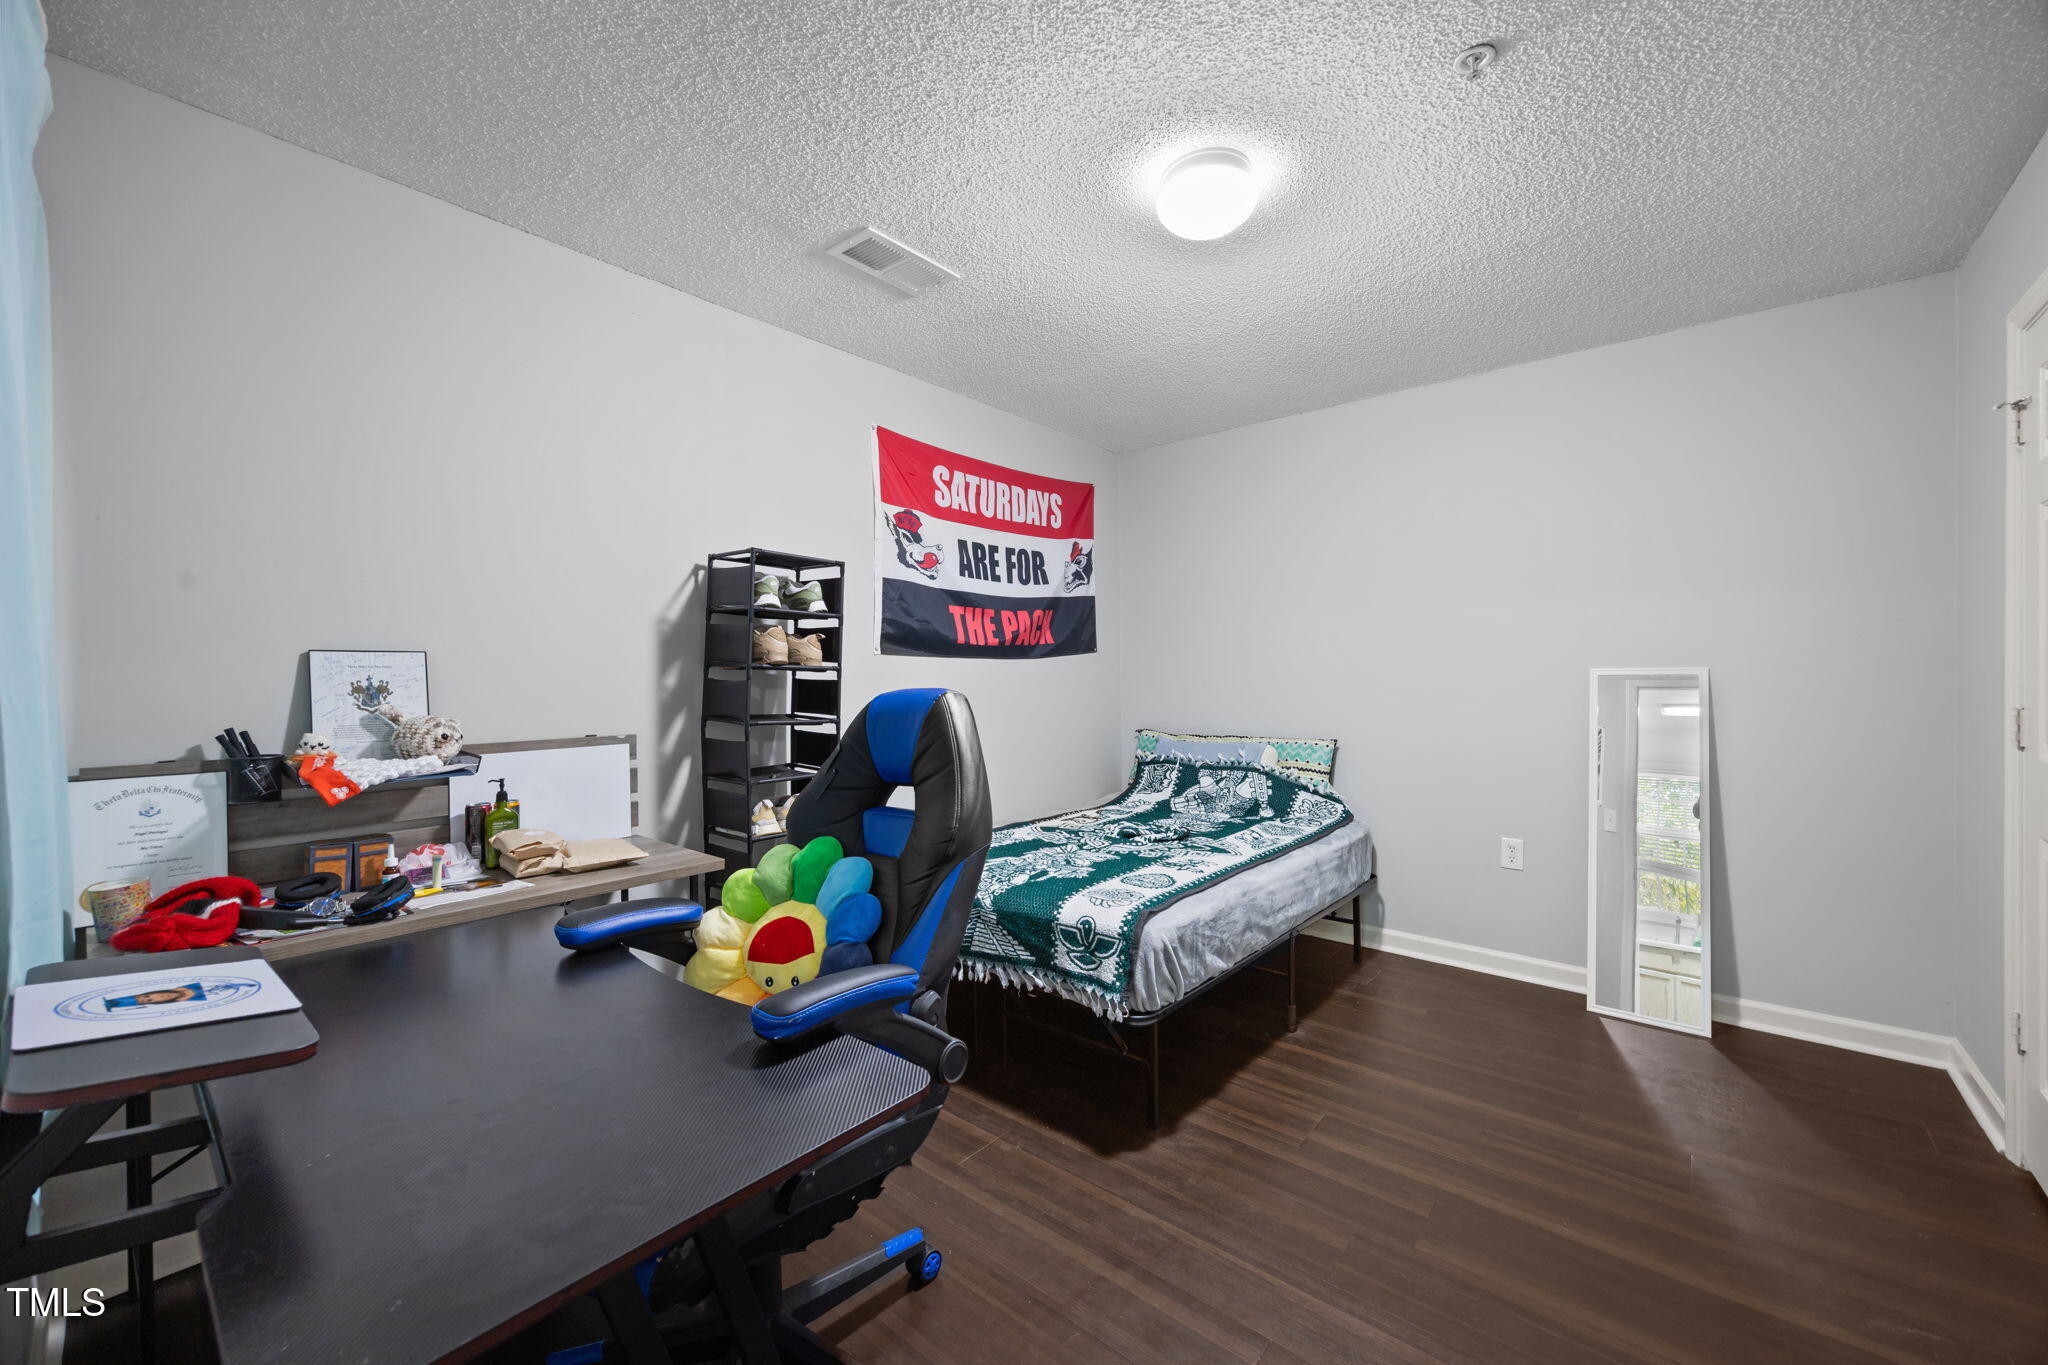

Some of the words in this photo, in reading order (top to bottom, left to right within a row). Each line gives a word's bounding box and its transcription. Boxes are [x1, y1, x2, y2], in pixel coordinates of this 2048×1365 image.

[932, 465, 1062, 530] SATURDAYS
[957, 538, 1001, 583] ARE
[1005, 546, 1050, 586] FOR
[948, 604, 1000, 646] THE
[1000, 609, 1055, 646] PACK
[161, 786, 202, 804] Fraternity
